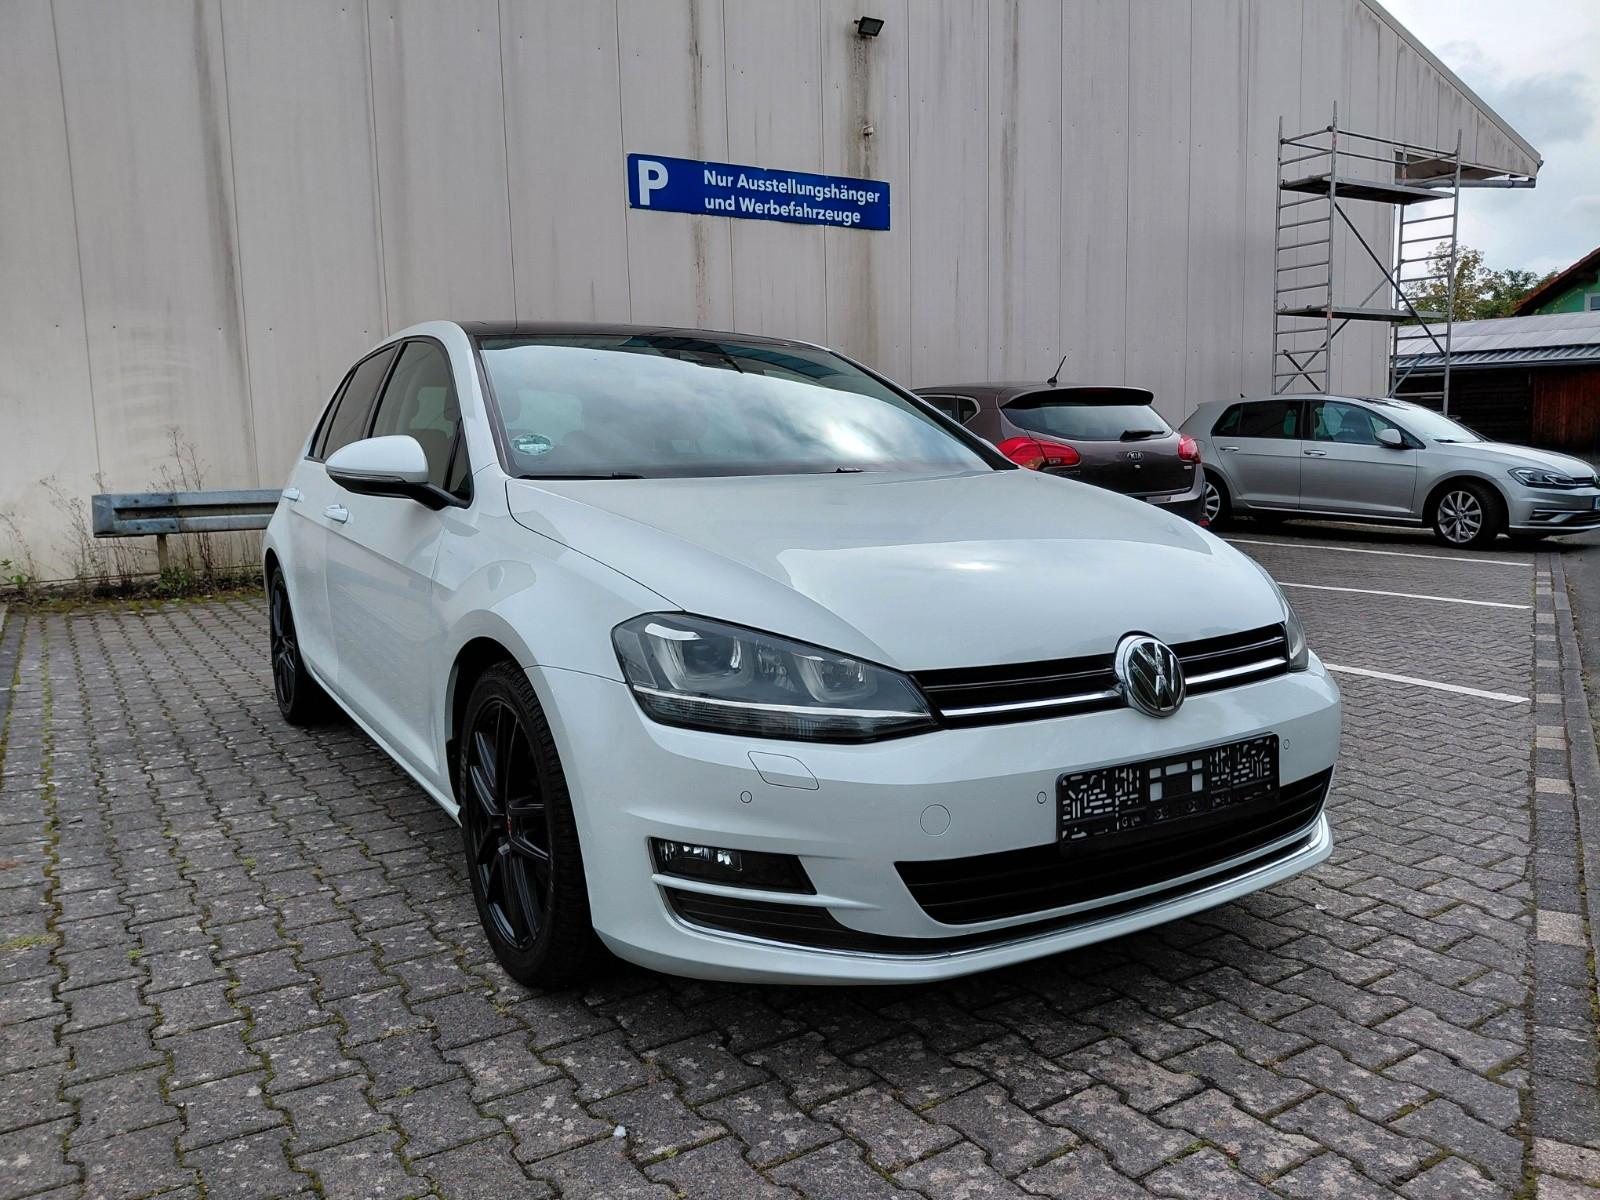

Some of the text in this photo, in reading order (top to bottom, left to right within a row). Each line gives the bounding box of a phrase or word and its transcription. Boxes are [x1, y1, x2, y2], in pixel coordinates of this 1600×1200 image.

[638, 159, 669, 206] P
[703, 169, 880, 206] Nur Ausstellungshänger
[704, 195, 862, 226] und Werbefahrzeuge
